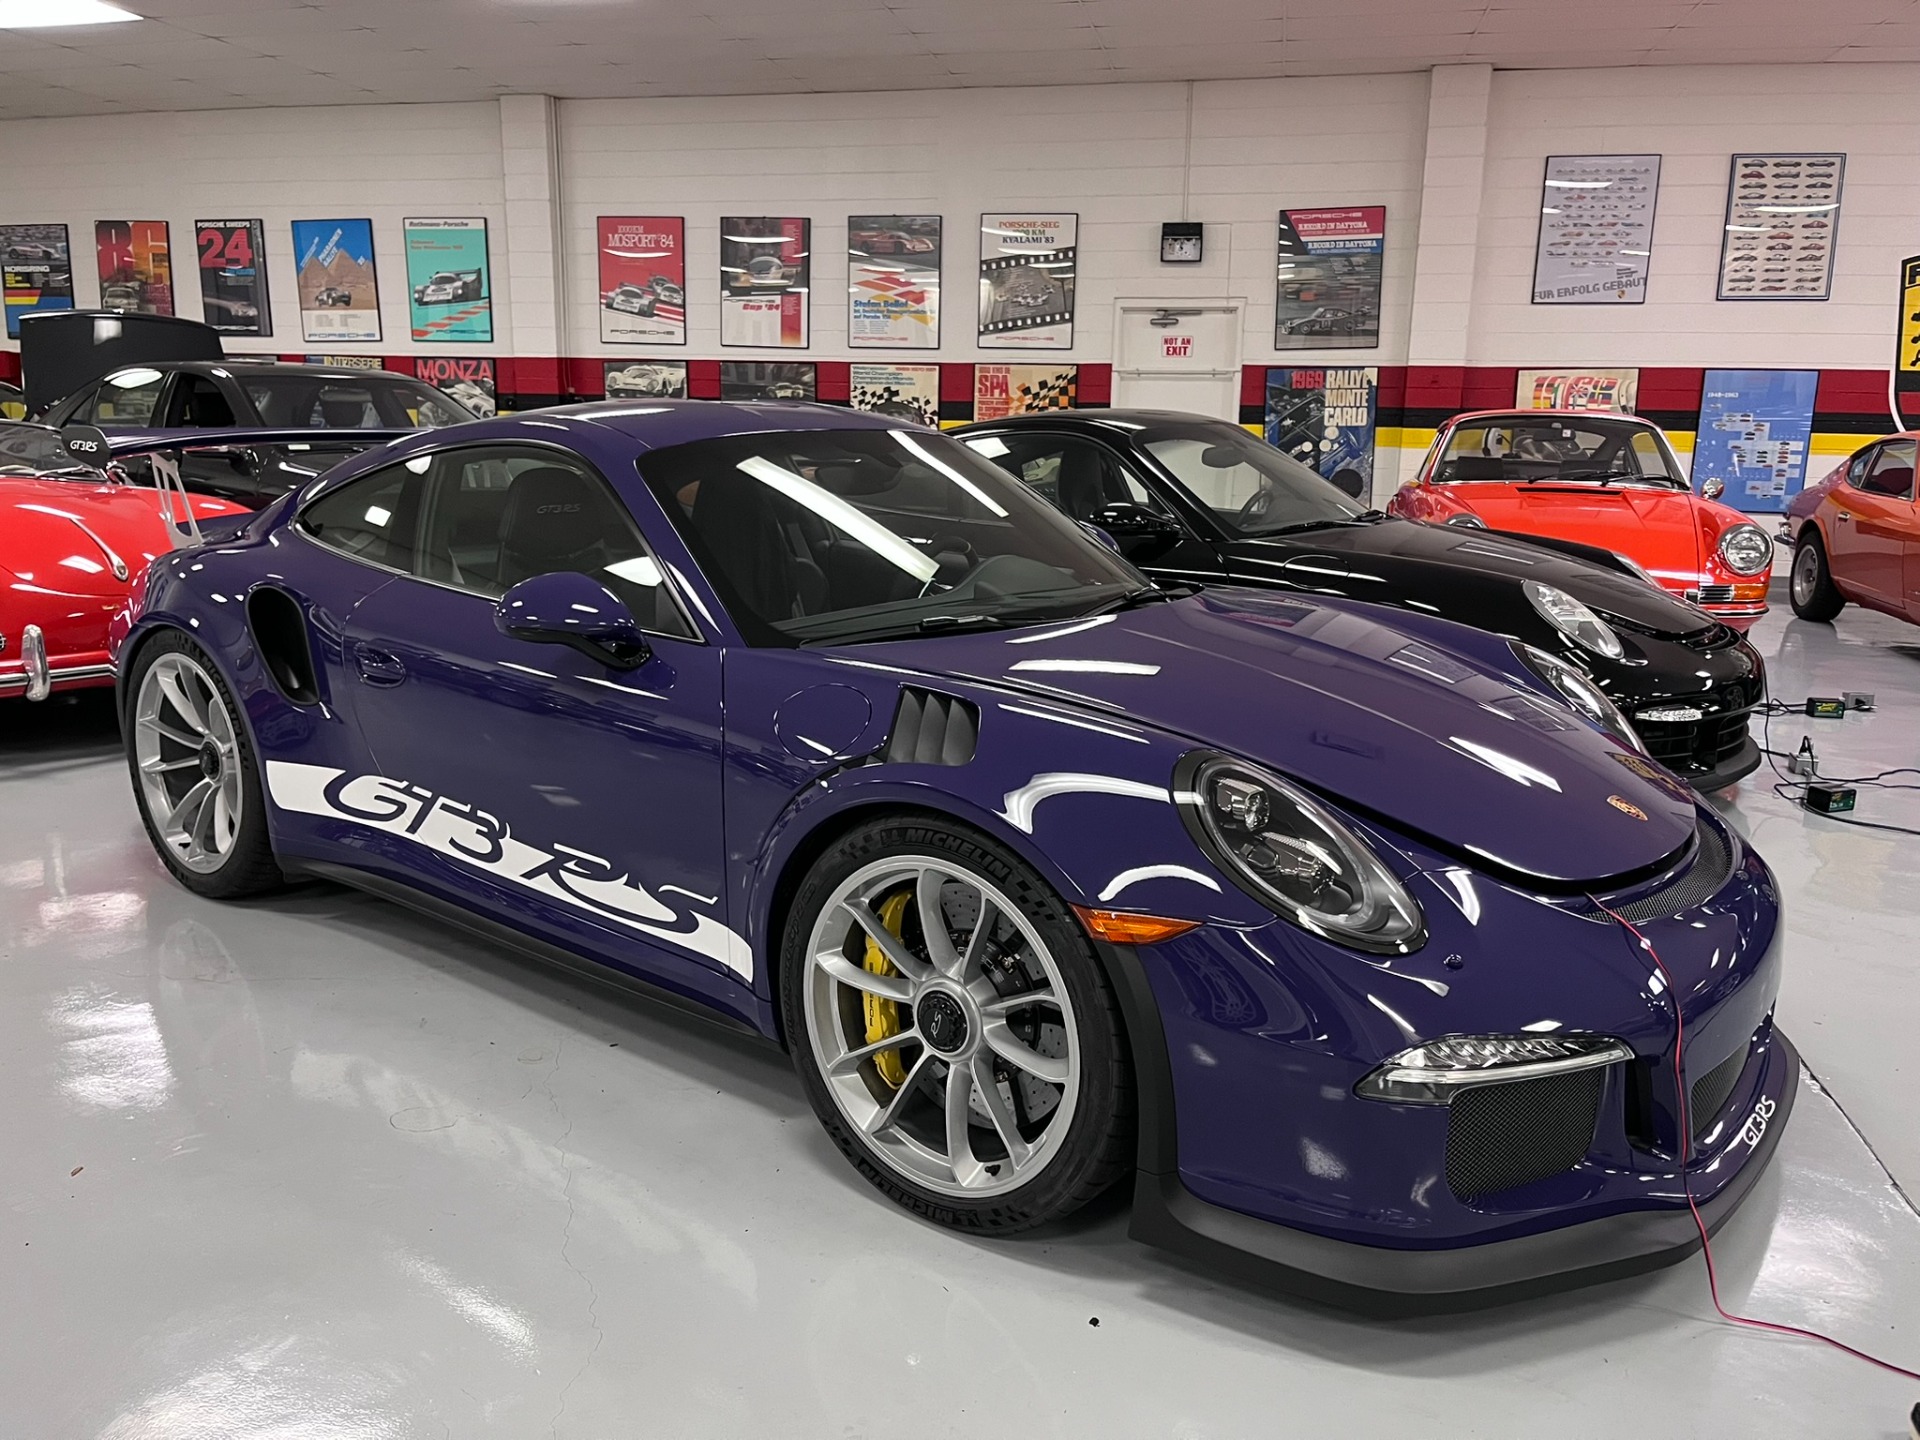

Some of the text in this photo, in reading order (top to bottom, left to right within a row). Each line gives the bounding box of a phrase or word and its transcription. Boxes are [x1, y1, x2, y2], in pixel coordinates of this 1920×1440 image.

[1291, 212, 1362, 220] PORSCHE
[1336, 221, 1368, 229] DAYTONA
[608, 233, 654, 247] MOSPORT
[1308, 241, 1335, 249] RECORD
[1345, 239, 1377, 248] DAYTONA
[198, 229, 253, 268] 24
[1556, 283, 1601, 298] ERFOLG
[742, 303, 763, 311] Cup
[1163, 337, 1191, 345] NOT AN
[1166, 346, 1188, 355] EXIT
[417, 359, 493, 381] MONZA
[979, 375, 1009, 397] SPA
[1291, 370, 1324, 389] 1969
[1324, 389, 1368, 407] MONTE
[1324, 408, 1368, 426] CARLO
[904, 828, 1011, 885] MICHELIN
[930, 1011, 942, 1038] RS
